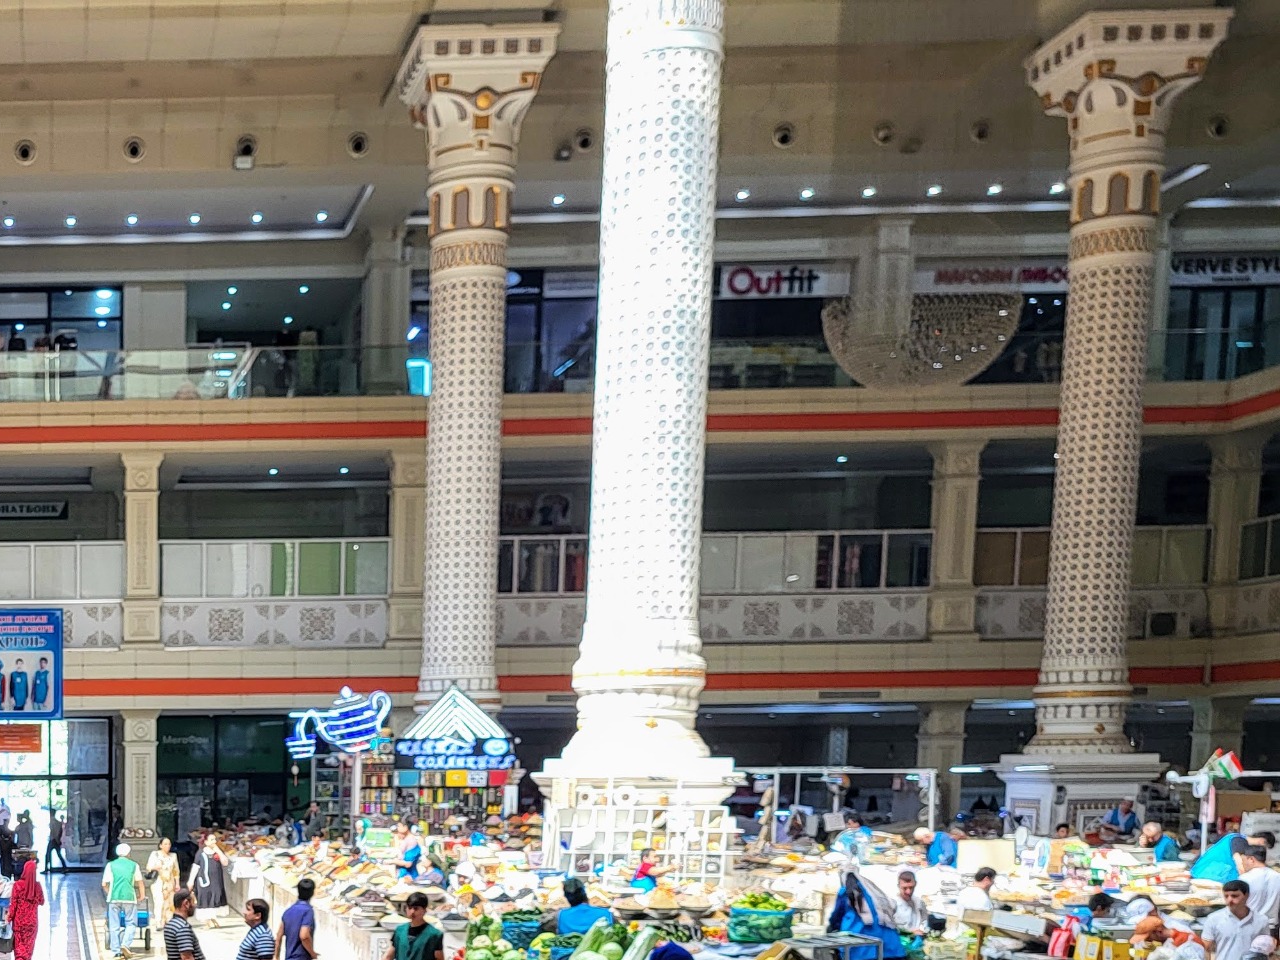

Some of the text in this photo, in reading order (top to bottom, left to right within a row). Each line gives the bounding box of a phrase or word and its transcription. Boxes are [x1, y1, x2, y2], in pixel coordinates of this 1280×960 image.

[1170, 256, 1280, 275] VERVE STYL
[727, 265, 820, 295] Outfit
